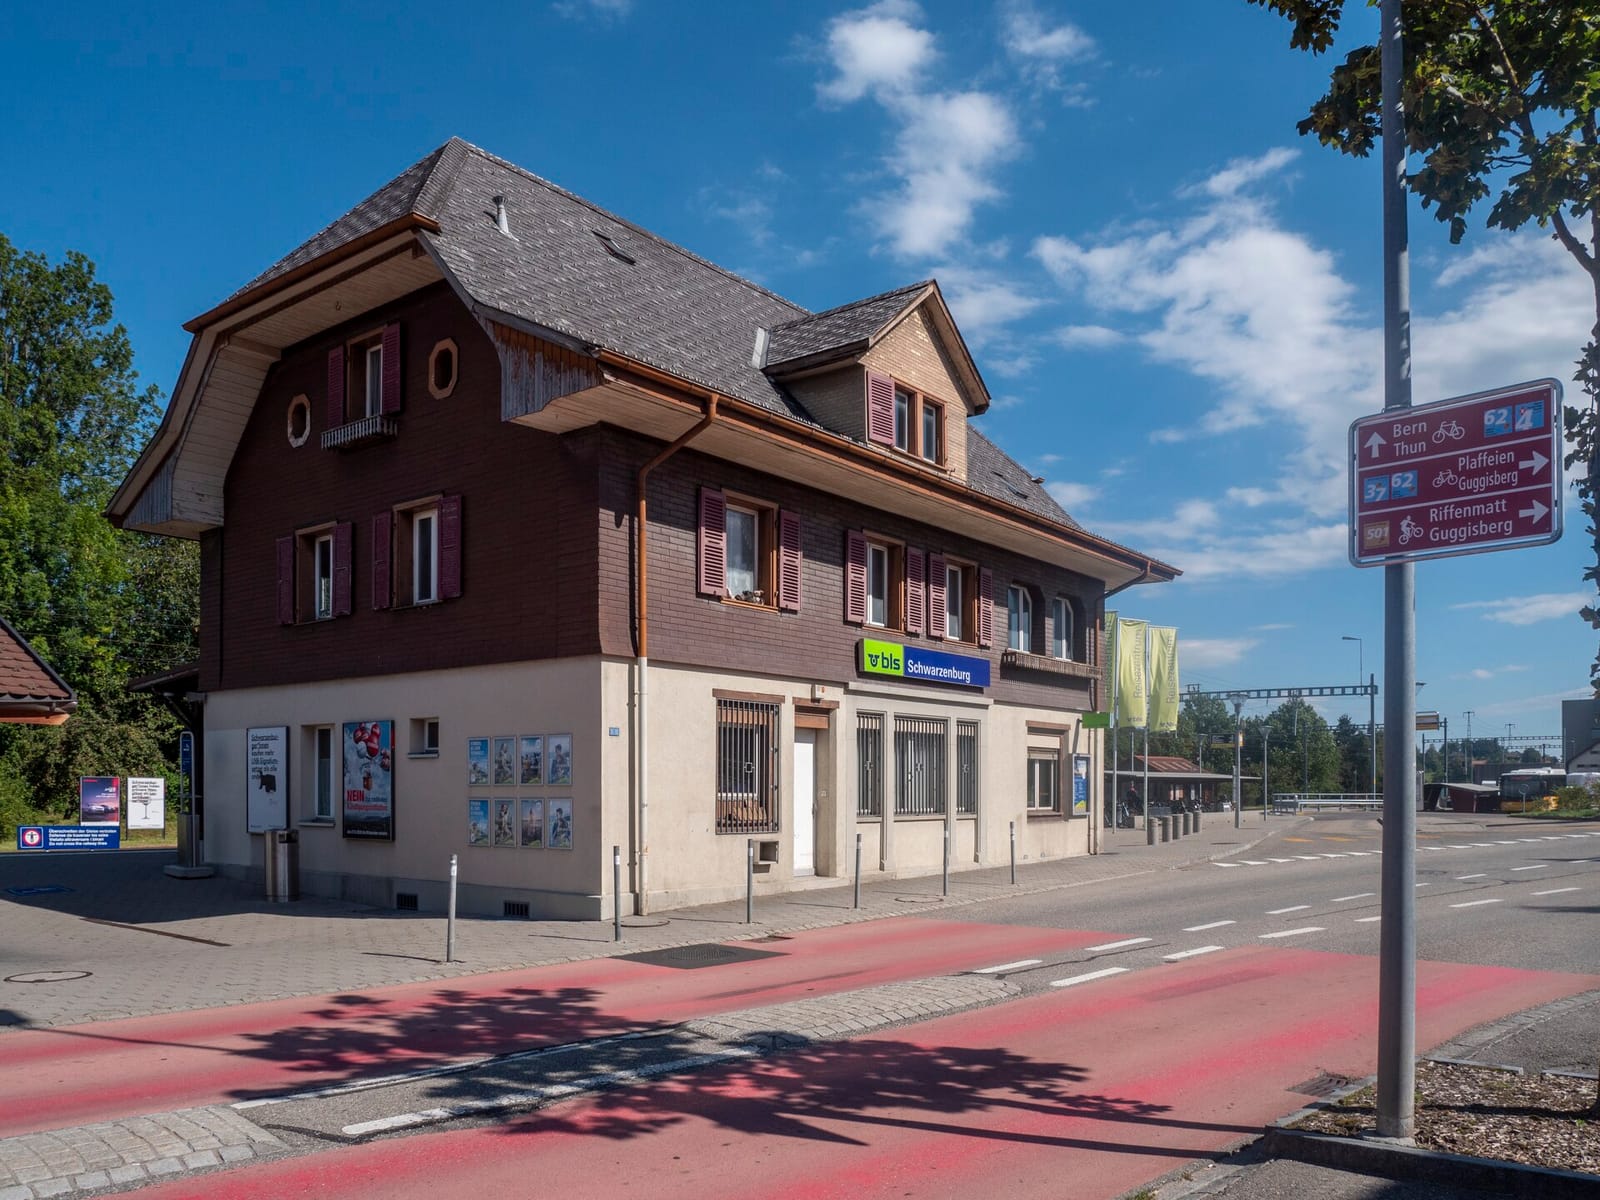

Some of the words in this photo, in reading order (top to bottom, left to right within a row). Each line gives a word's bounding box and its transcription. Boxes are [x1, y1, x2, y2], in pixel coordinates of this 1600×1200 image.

[1484, 408, 1508, 425] 62
[1393, 420, 1427, 438] Bern
[1393, 440, 1426, 457] Thun
[1458, 450, 1515, 471] Plaffeien
[1391, 472, 1413, 488] 62
[1458, 470, 1518, 492] Guggisberg
[1364, 484, 1387, 501] 37
[1429, 499, 1508, 522] Riffenmatt
[1367, 527, 1389, 540] 501
[1429, 520, 1513, 543] Guggisberg
[882, 652, 900, 670] bls
[1134, 629, 1143, 698] Reisezentrum
[907, 659, 970, 683] Schwarzenburg
[347, 790, 364, 801] NEIN
